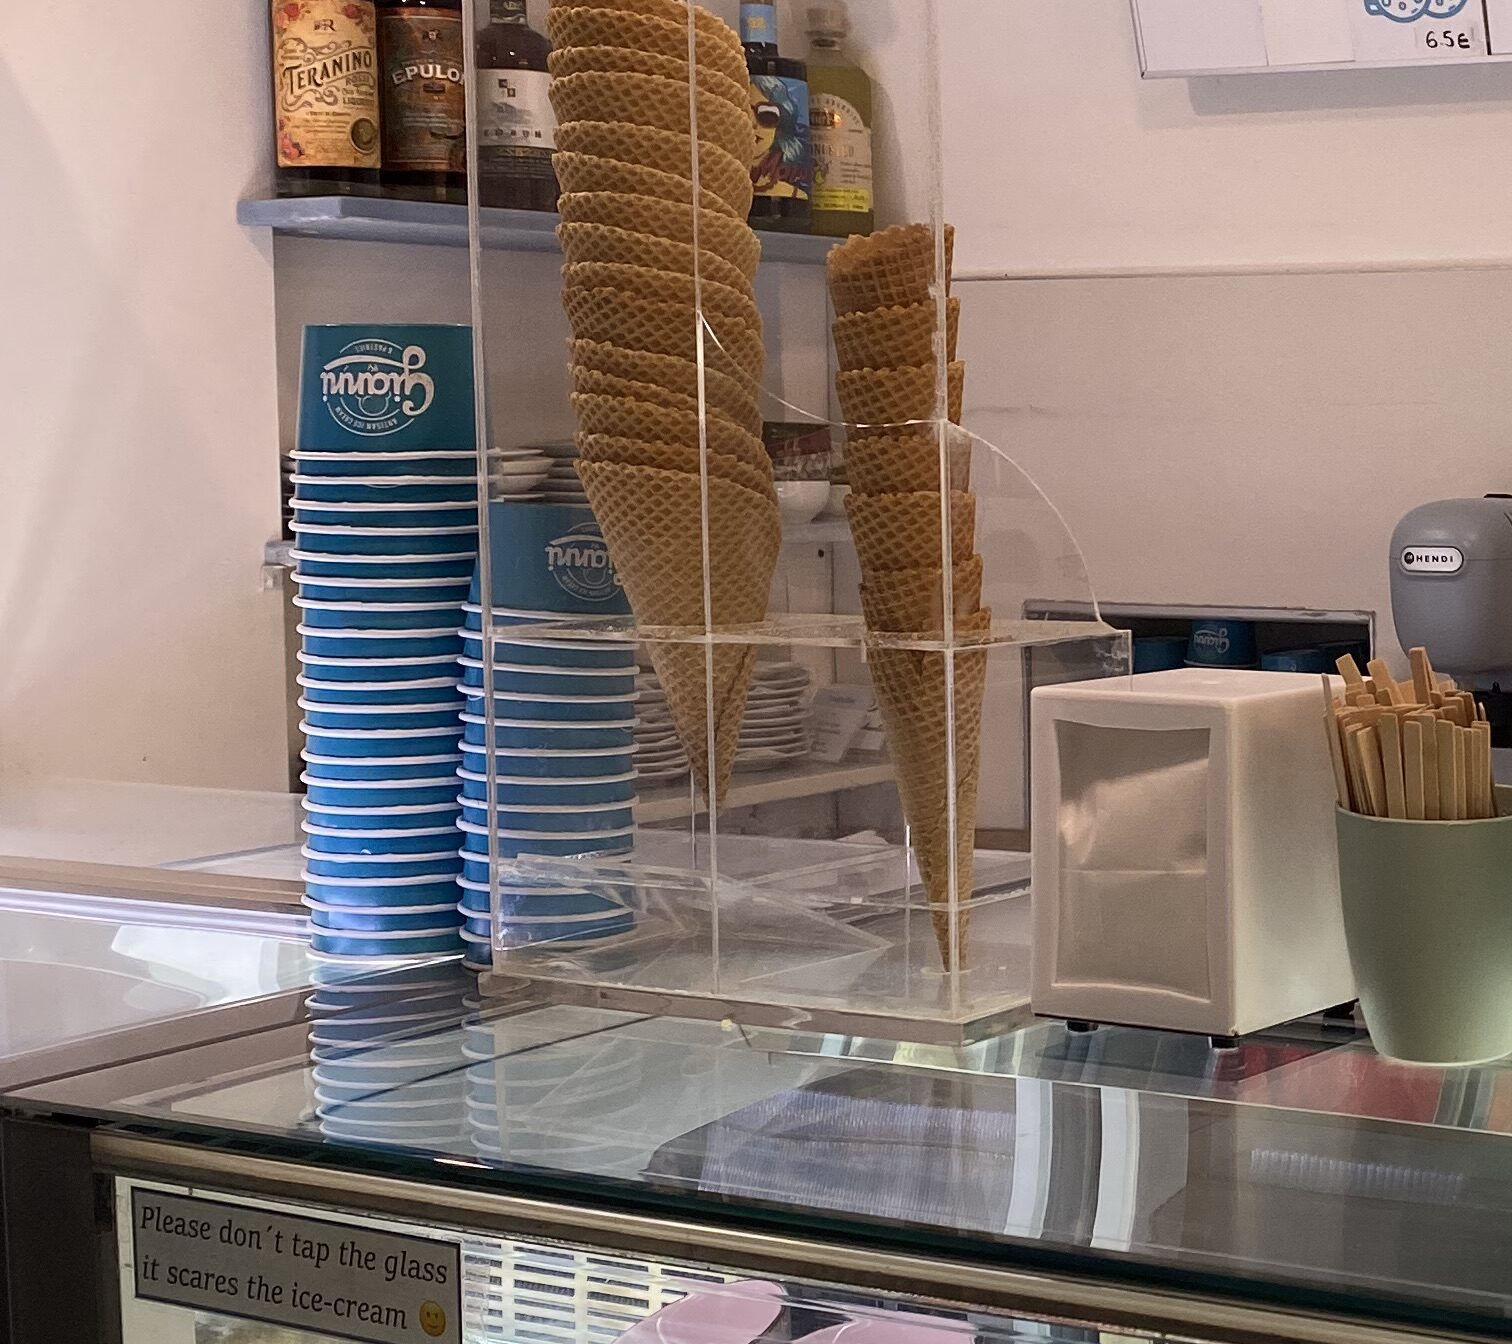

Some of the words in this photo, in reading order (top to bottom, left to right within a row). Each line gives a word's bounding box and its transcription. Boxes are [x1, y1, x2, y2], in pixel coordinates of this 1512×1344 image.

[282, 49, 373, 95] TERANINO
[320, 345, 434, 417] Gianni
[1416, 554, 1454, 563] HENDI
[141, 1206, 211, 1240] Please
[293, 1233, 329, 1267] tap
[339, 1240, 376, 1270] the
[384, 1248, 447, 1284] glass
[142, 1255, 159, 1281] it
[167, 1265, 239, 1295] scares
[247, 1275, 283, 1304] the
[291, 1282, 407, 1329] ice-cream
